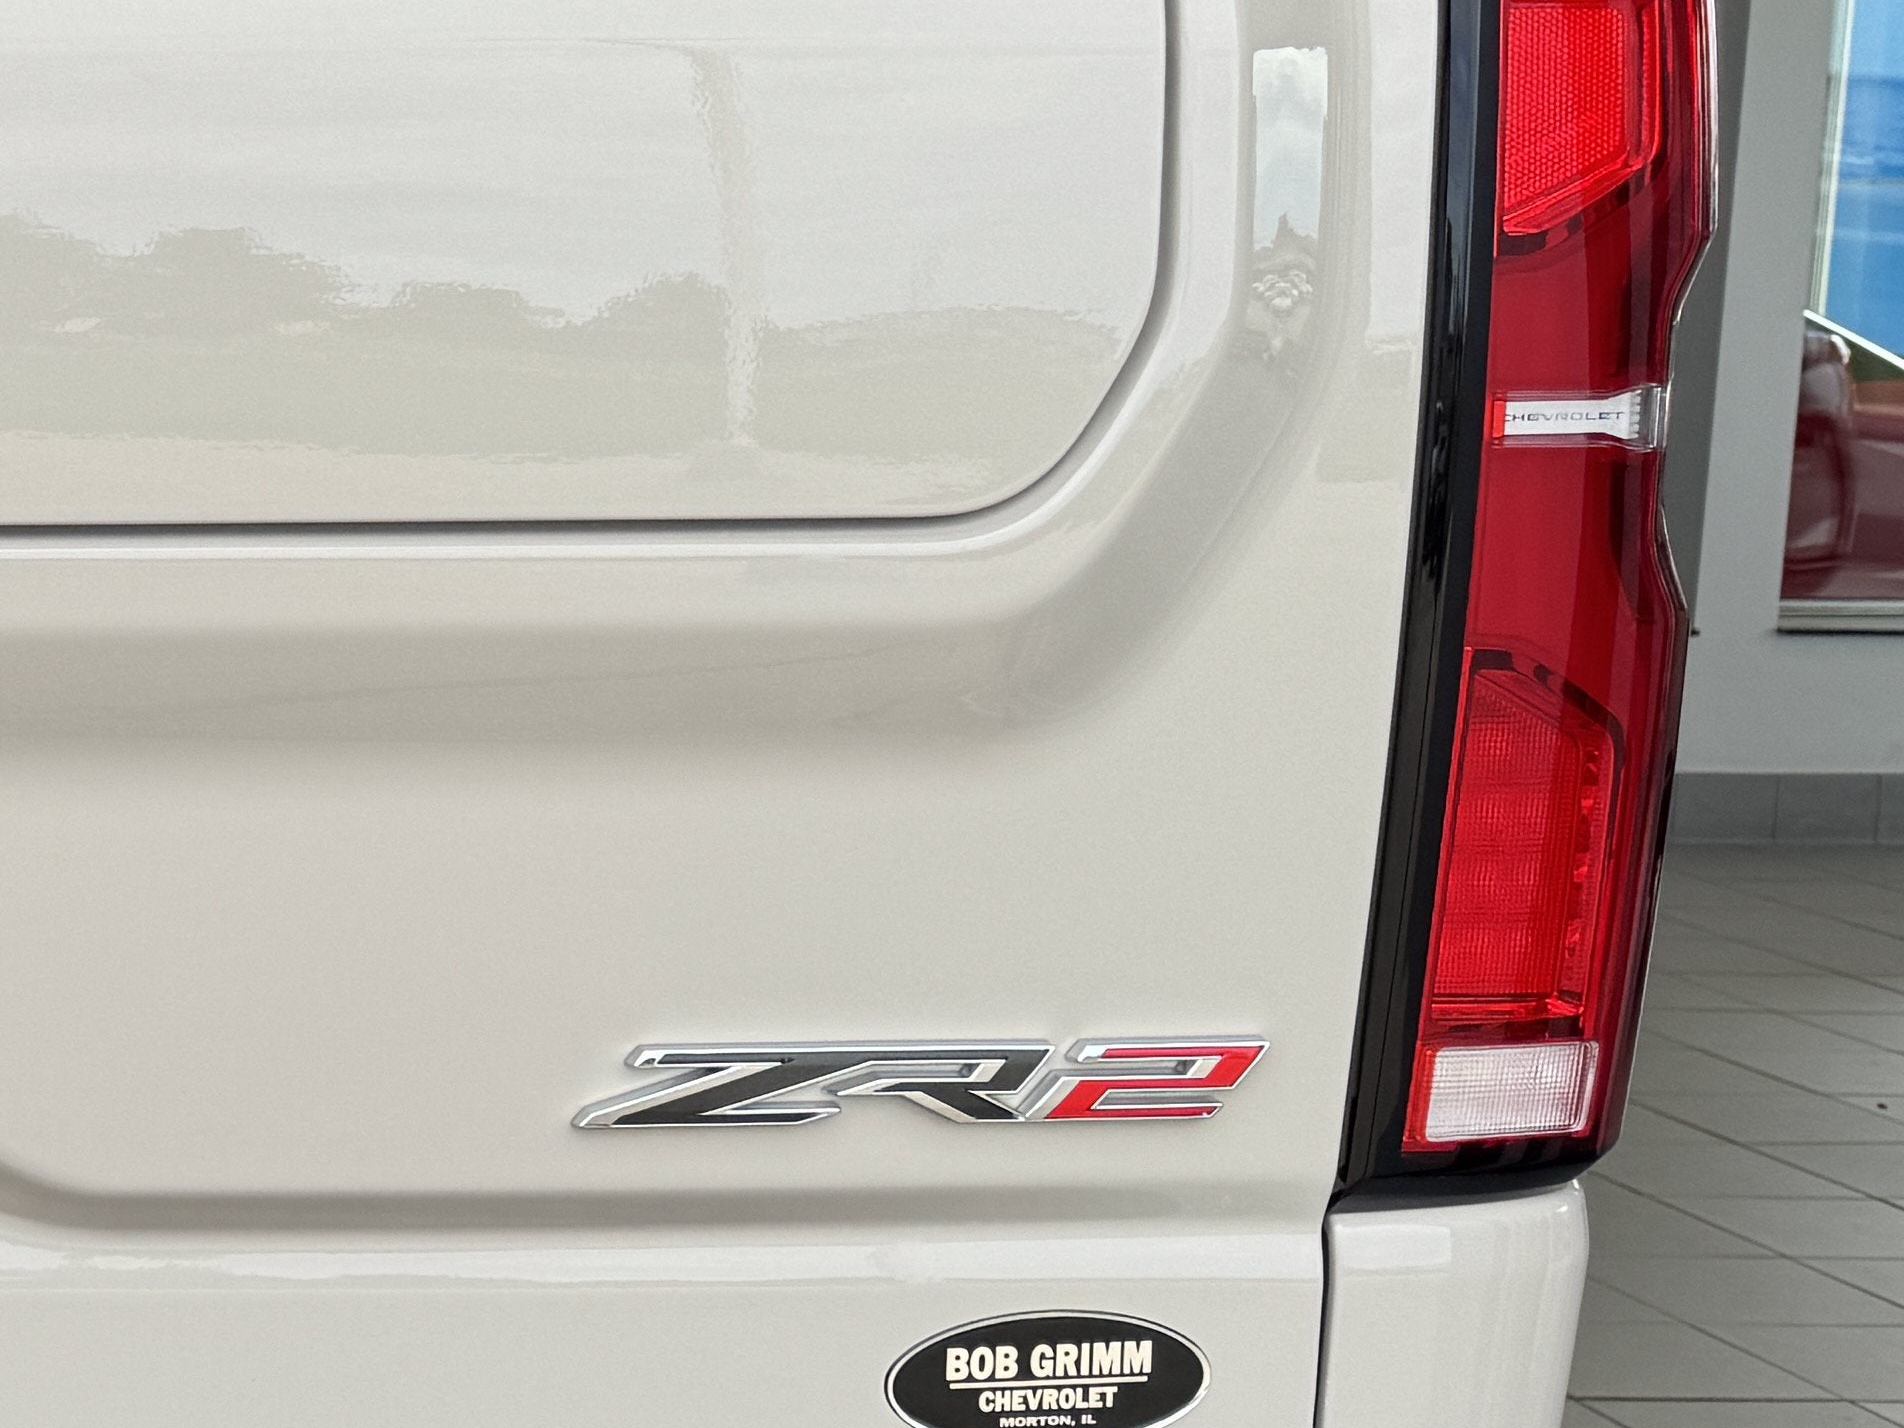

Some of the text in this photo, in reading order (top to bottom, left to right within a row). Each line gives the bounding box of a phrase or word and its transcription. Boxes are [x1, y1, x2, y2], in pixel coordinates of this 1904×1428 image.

[571, 1035, 1272, 1130] ZR2
[945, 1339, 1153, 1383] BOB GRIMM
[978, 1386, 1119, 1414] CHEVROLET
[999, 1414, 1097, 1428] MORTON, IL
